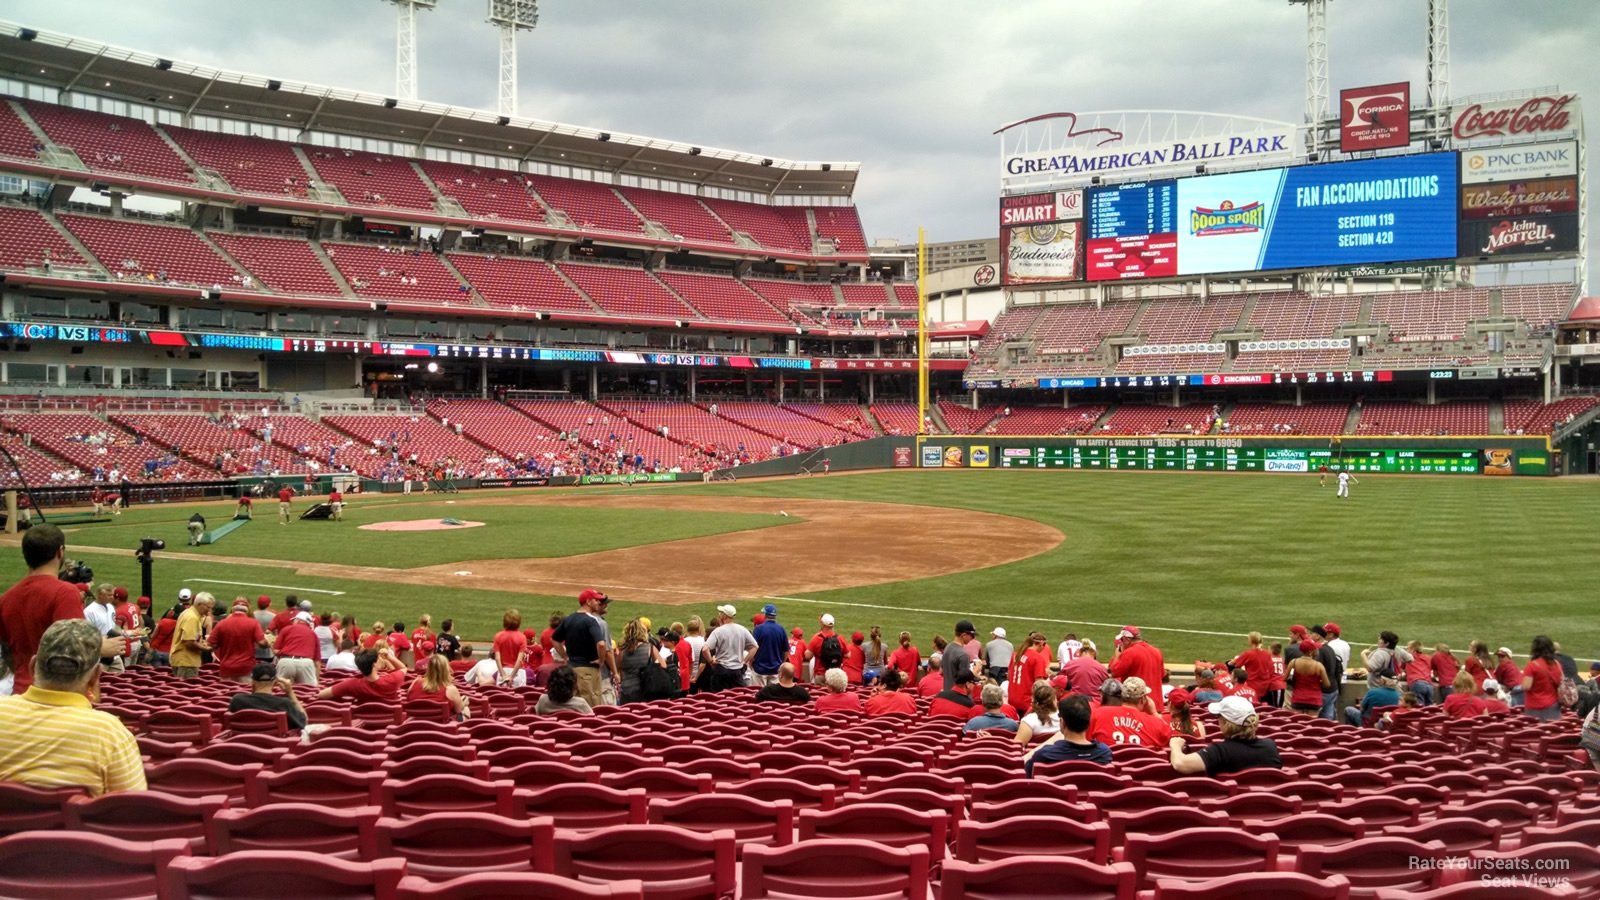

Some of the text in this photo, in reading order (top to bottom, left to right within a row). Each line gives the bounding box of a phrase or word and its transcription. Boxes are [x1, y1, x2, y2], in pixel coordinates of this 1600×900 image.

[1359, 104, 1402, 115] FORMICA
[1453, 93, 1577, 139] Coca-Cola
[1007, 135, 1288, 175] GREAT AMERICAN BALL PARK
[1488, 149, 1568, 167] PNC BANK
[1297, 175, 1439, 207] FAN ACCOMMODATIONS
[1466, 188, 1570, 210] Walgreens
[1004, 205, 1053, 223] SMART
[1191, 205, 1264, 232] GOOD SPORT
[1338, 213, 1394, 229] SECTION 119
[1508, 220, 1536, 233] John
[1338, 231, 1394, 247] SECTION 420
[1482, 224, 1555, 252] Morrell
[1008, 246, 1075, 260] Budweiser
[1340, 265, 1451, 277] ULTIMATE AIR SHUTTLE
[63, 328, 84, 339] VS
[679, 356, 692, 364] VS
[1216, 439, 1242, 447] 69050
[1012, 665, 1022, 685] 11
[1273, 662, 1284, 674] 19
[1113, 716, 1143, 733] BRUCE
